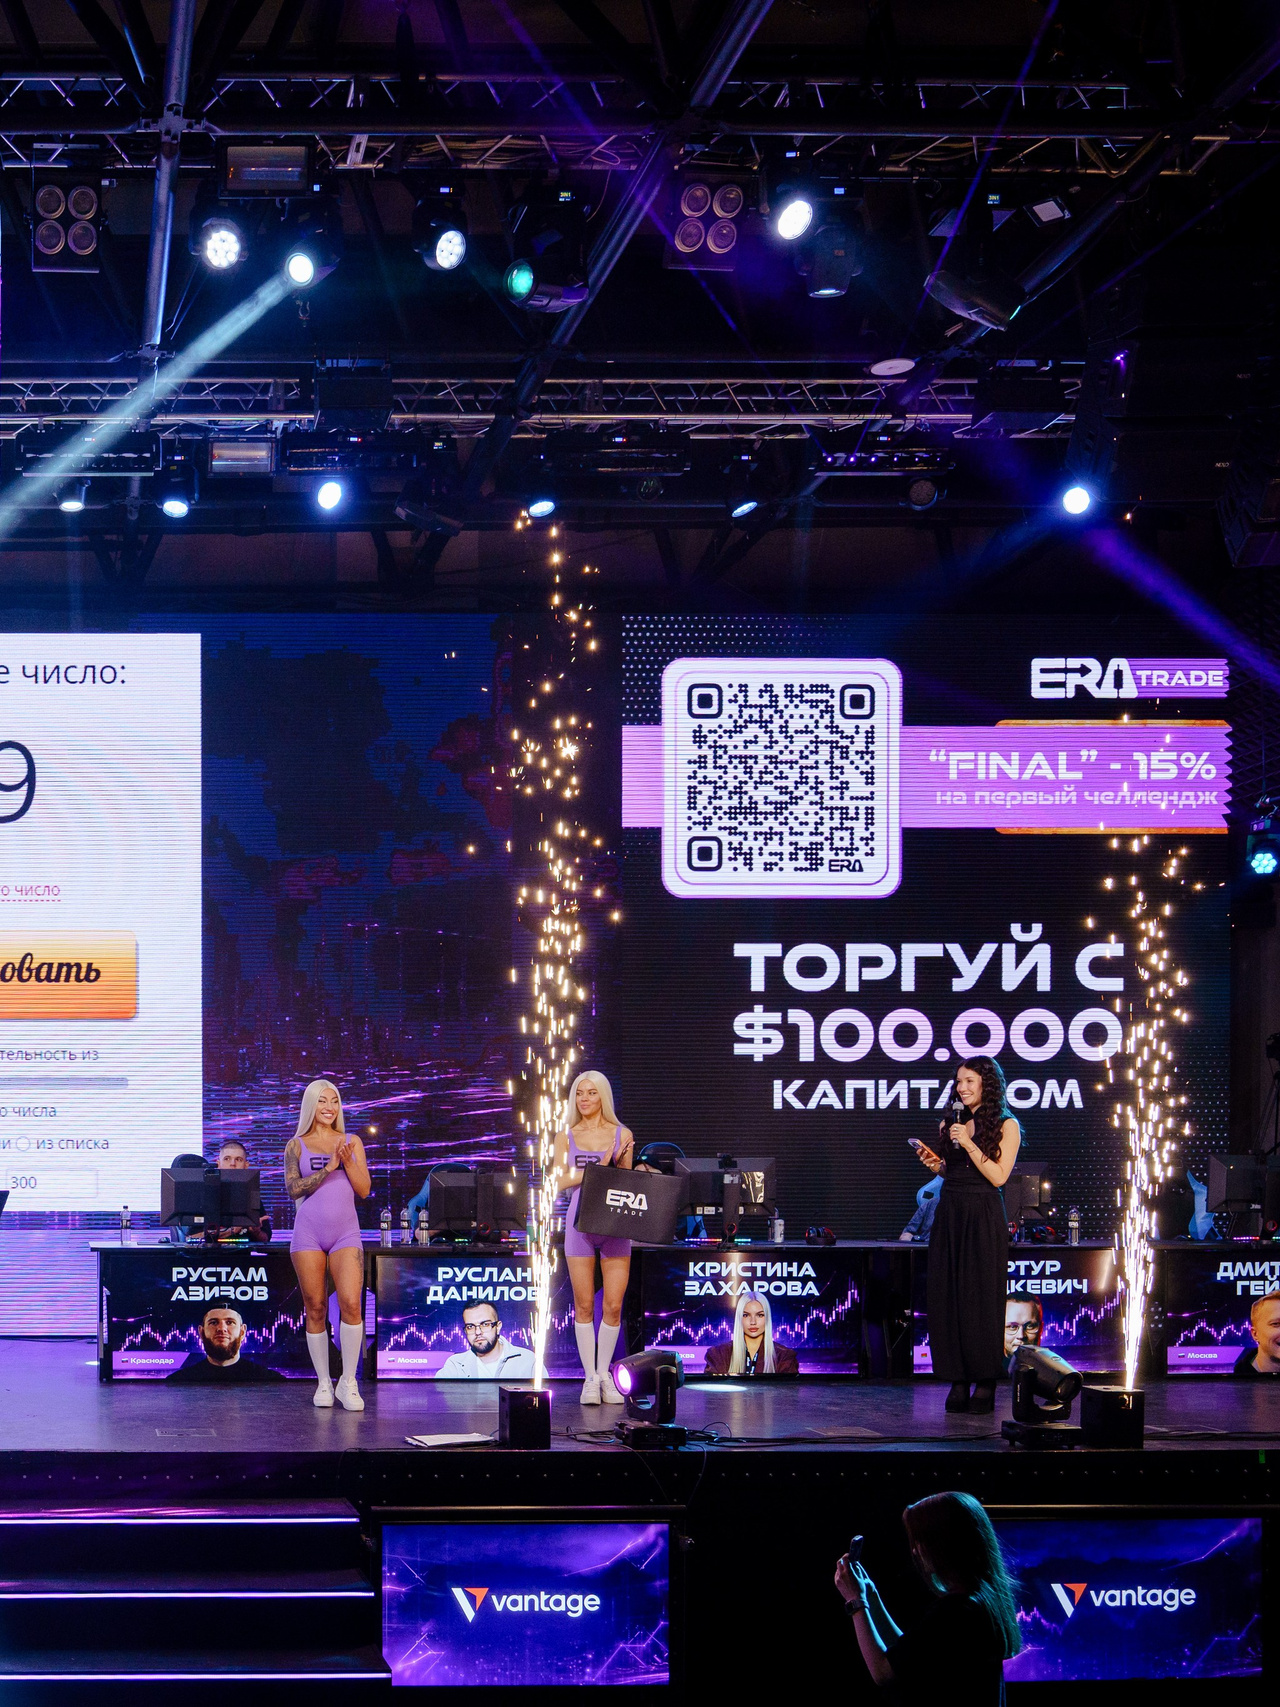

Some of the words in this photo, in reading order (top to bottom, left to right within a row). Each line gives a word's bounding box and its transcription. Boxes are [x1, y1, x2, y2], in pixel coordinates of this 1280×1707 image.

[22, 662, 127, 685] число:
[1030, 657, 1138, 699] ERA
[1135, 670, 1224, 687] TRADE
[935, 790, 968, 805] на
[974, 784, 1078, 808] первый
[1084, 790, 1219, 808] челлендж
[828, 859, 864, 872] ERA
[14, 885, 61, 897] число
[733, 922, 1052, 993] ТОРГУЙ
[1074, 942, 1125, 993] С
[732, 1004, 1124, 1062] $100.000
[82, 1050, 99, 1061] из
[12, 1106, 57, 1118] числа
[36, 1138, 54, 1150] из
[58, 1138, 110, 1150] списка
[10, 1177, 38, 1189] 300
[606, 1188, 649, 1211] ERA
[609, 1206, 644, 1217] TRADE
[171, 1266, 268, 1283] РУСТАМ
[437, 1266, 532, 1283] РУСЛАН
[688, 1261, 816, 1277] КРИСТИНА
[1216, 1261, 1280, 1281] ДМИТ
[169, 1285, 269, 1301] АЗИЗОВ
[684, 1280, 820, 1296] ЗАХАРОВА
[1006, 1278, 1088, 1295] КЕВИЧ
[1236, 1275, 1280, 1296] ГЕЙ
[130, 1356, 174, 1366] Краснодар
[397, 1356, 427, 1364] Москва
[491, 1592, 600, 1618] vantage
[1090, 1585, 1197, 1611] vantage
